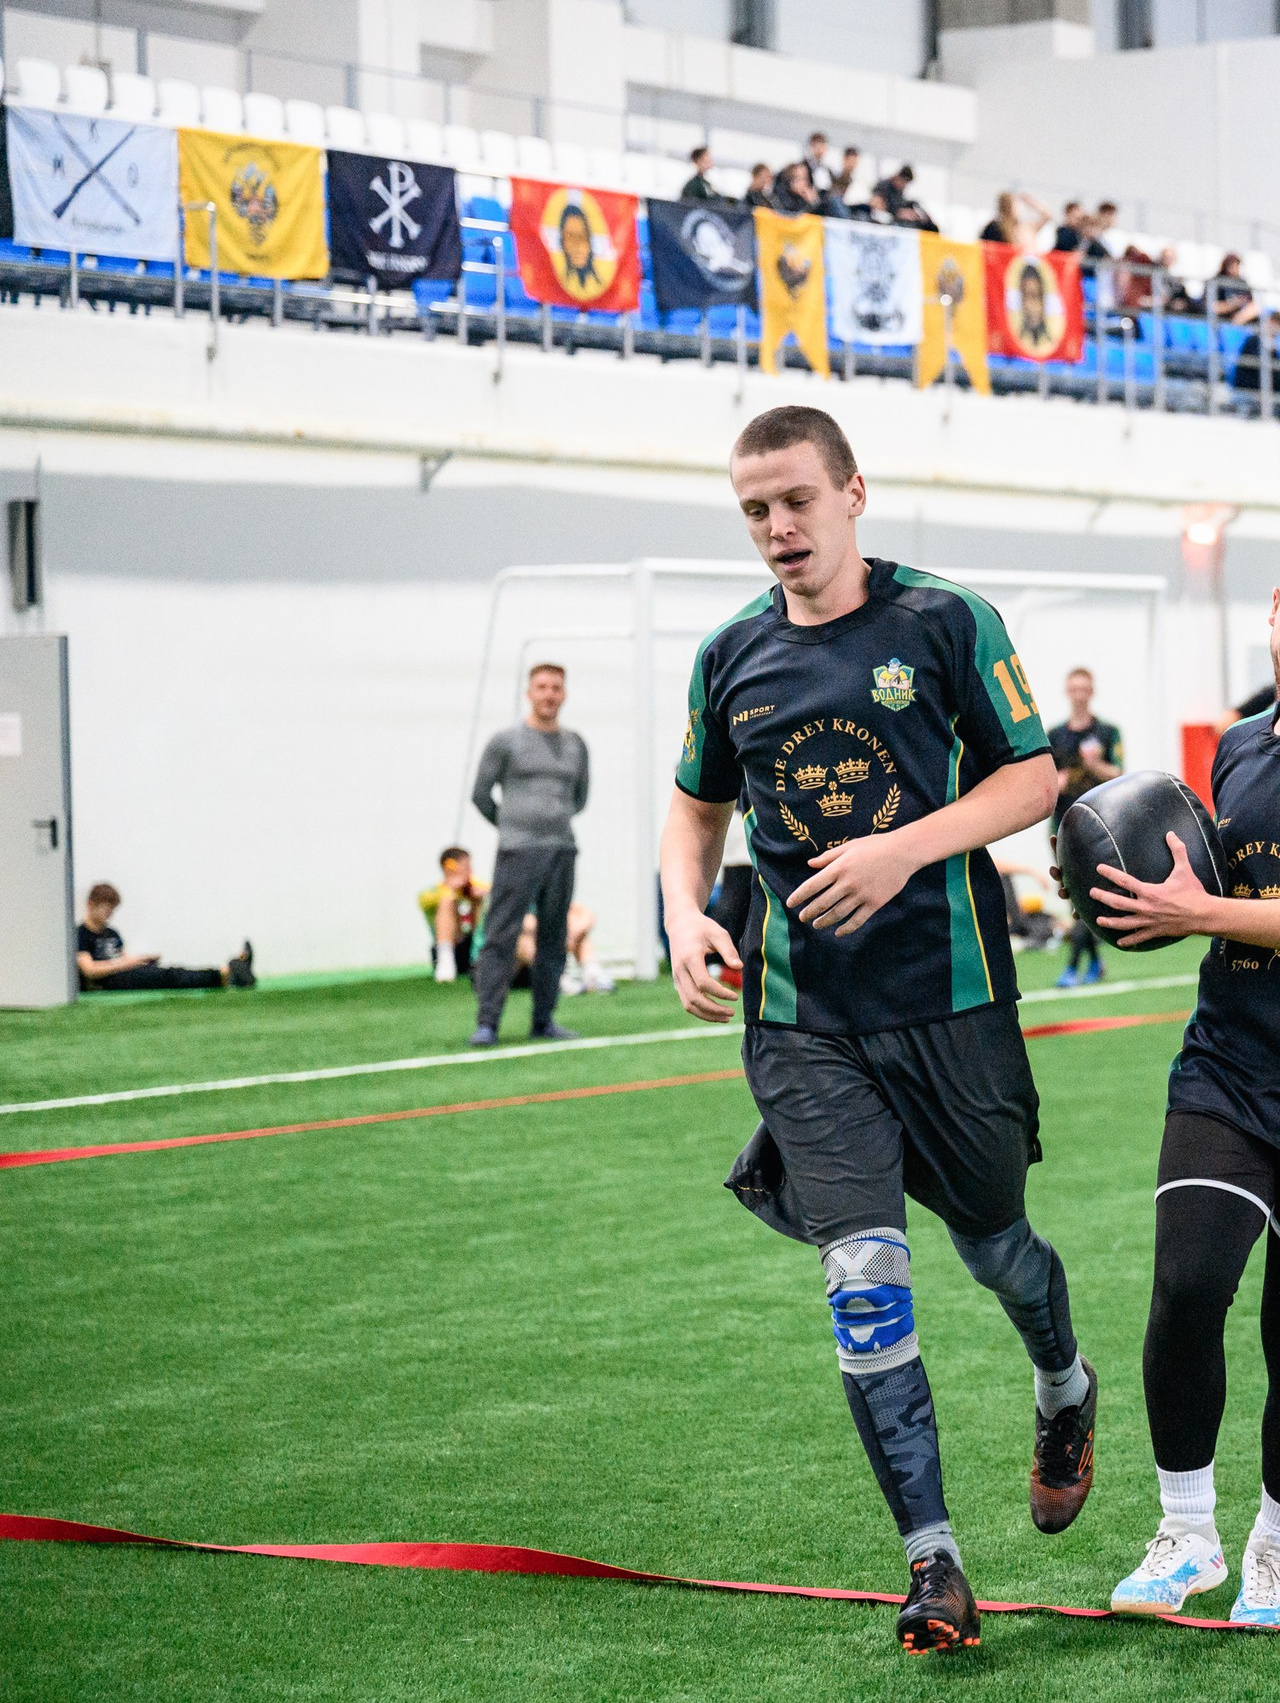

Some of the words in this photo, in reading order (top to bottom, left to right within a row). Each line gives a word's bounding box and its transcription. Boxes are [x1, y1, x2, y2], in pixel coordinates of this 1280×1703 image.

[871, 688, 916, 703] ВОДНИК
[749, 704, 775, 716] SPORT
[774, 758, 787, 792] DIE
[781, 719, 825, 755] DREY
[832, 718, 897, 774] KRONEN
[1228, 841, 1265, 870] DREY
[1230, 957, 1260, 972] 5760
